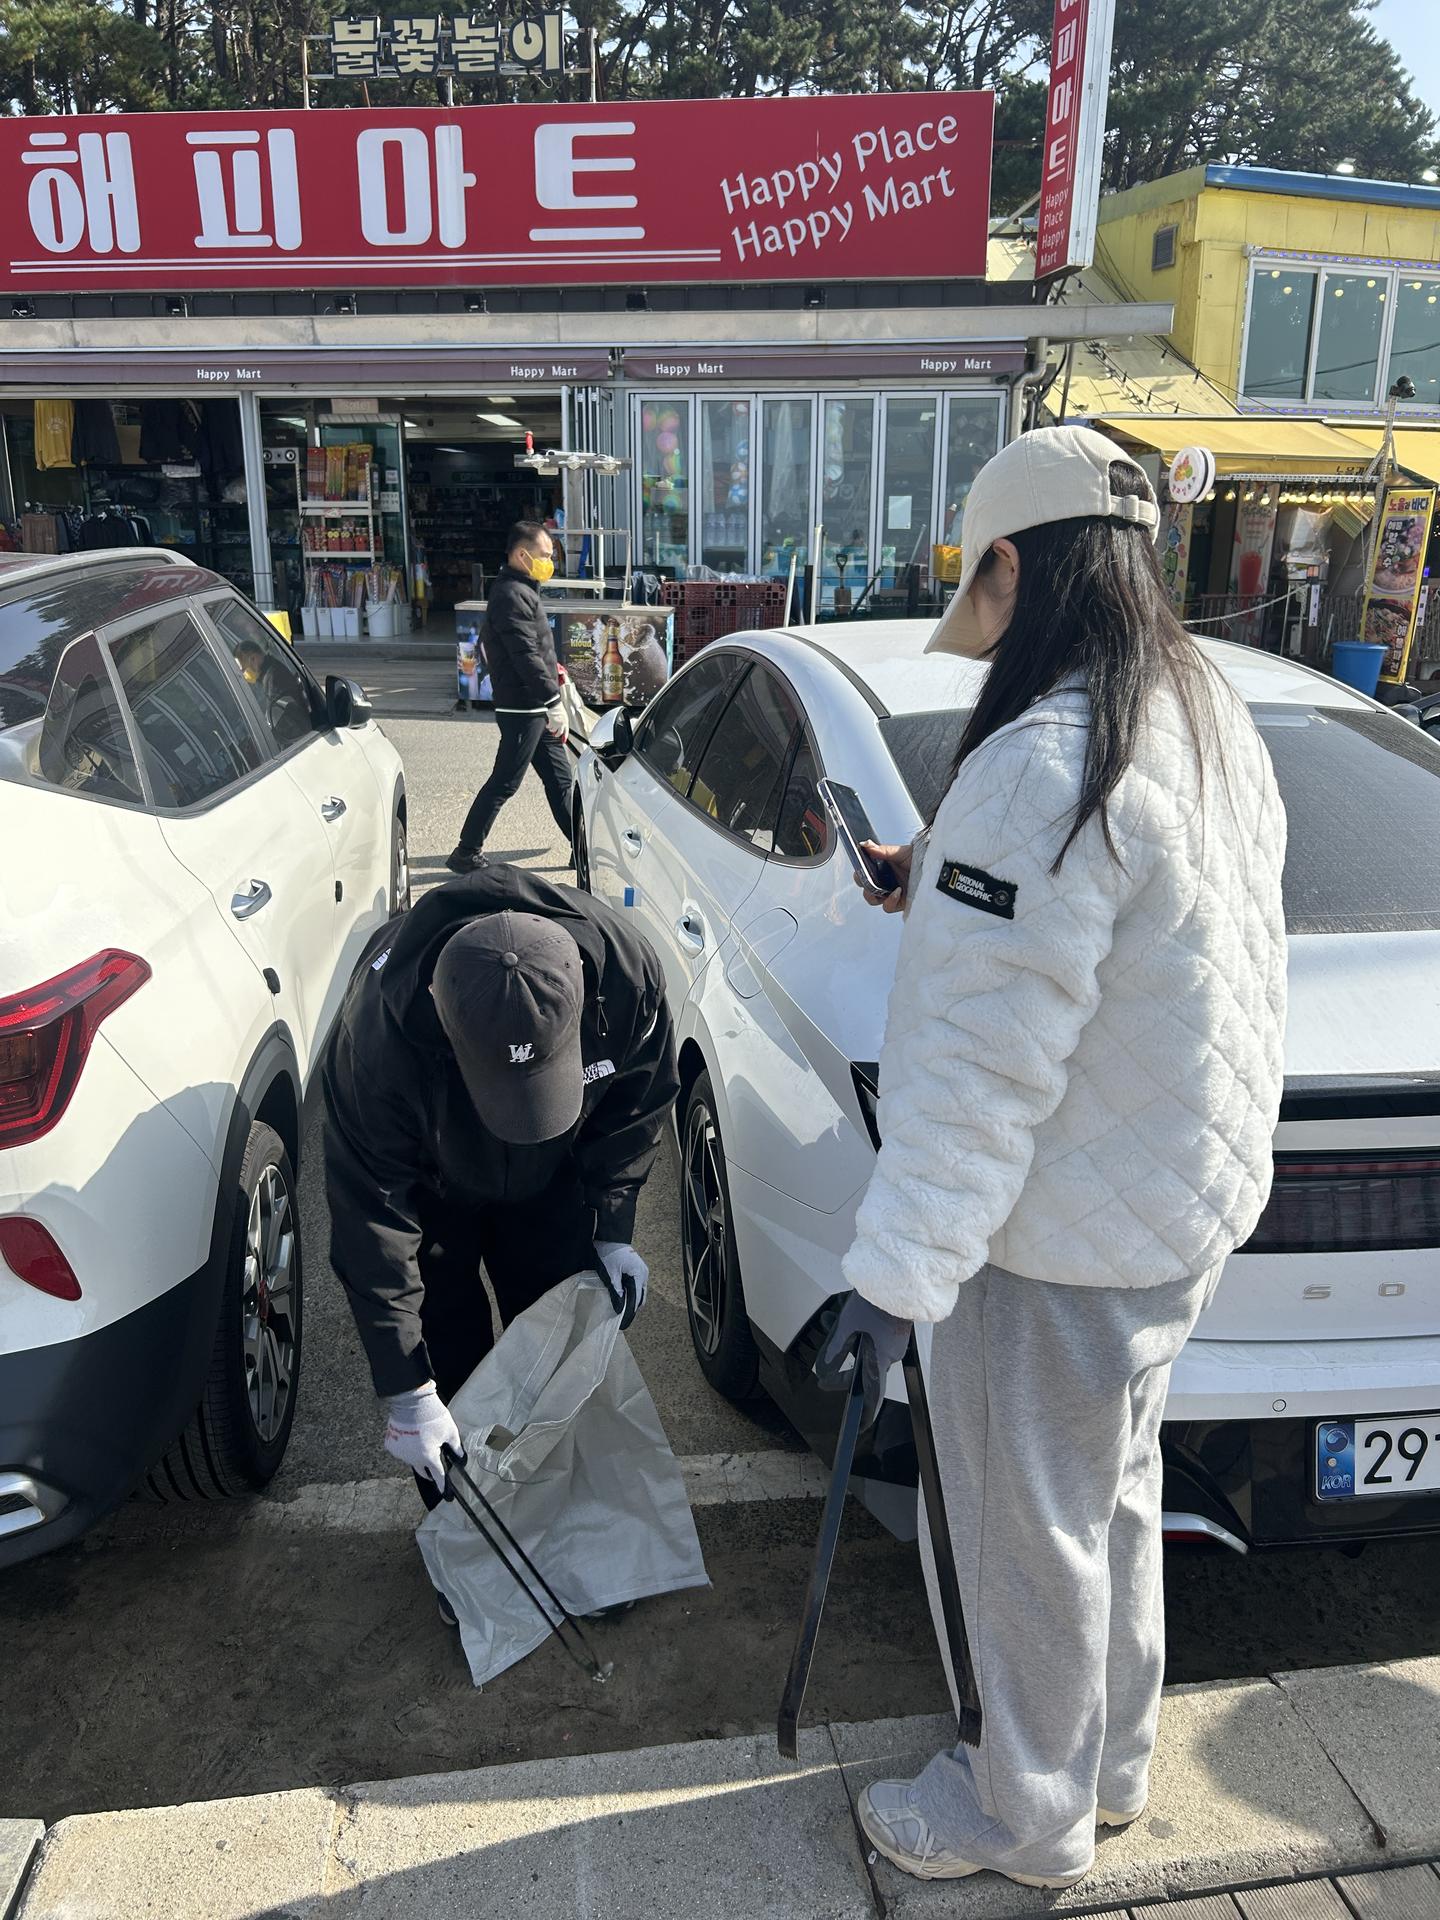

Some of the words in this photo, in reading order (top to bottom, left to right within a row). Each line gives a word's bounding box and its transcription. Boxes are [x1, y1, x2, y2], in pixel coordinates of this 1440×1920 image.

[331, 13, 563, 76] 불꽃놀이
[720, 152, 842, 215] Happy
[852, 115, 959, 173] Place
[21, 121, 646, 253] 해피마트
[1045, 187, 1069, 210] Happy
[731, 201, 853, 263] Happy
[861, 166, 956, 222] Mart
[1043, 209, 1064, 230] Place
[1041, 229, 1066, 250] Happy
[1040, 251, 1057, 268] Mart
[197, 369, 230, 380] Happy
[236, 368, 262, 379] Mart
[510, 366, 545, 377] Happy
[552, 366, 577, 376] Mart
[655, 364, 691, 375] Happy
[698, 363, 724, 374] Mart
[920, 359, 957, 372] Happy
[964, 358, 992, 369] Mart
[956, 882, 992, 902] GEOGRAPHIC
[959, 874, 985, 891] NATIONAL
[582, 1073, 600, 1087] ACE
[1363, 1427, 1440, 1485] 29
[1321, 1474, 1352, 1490] KOR
